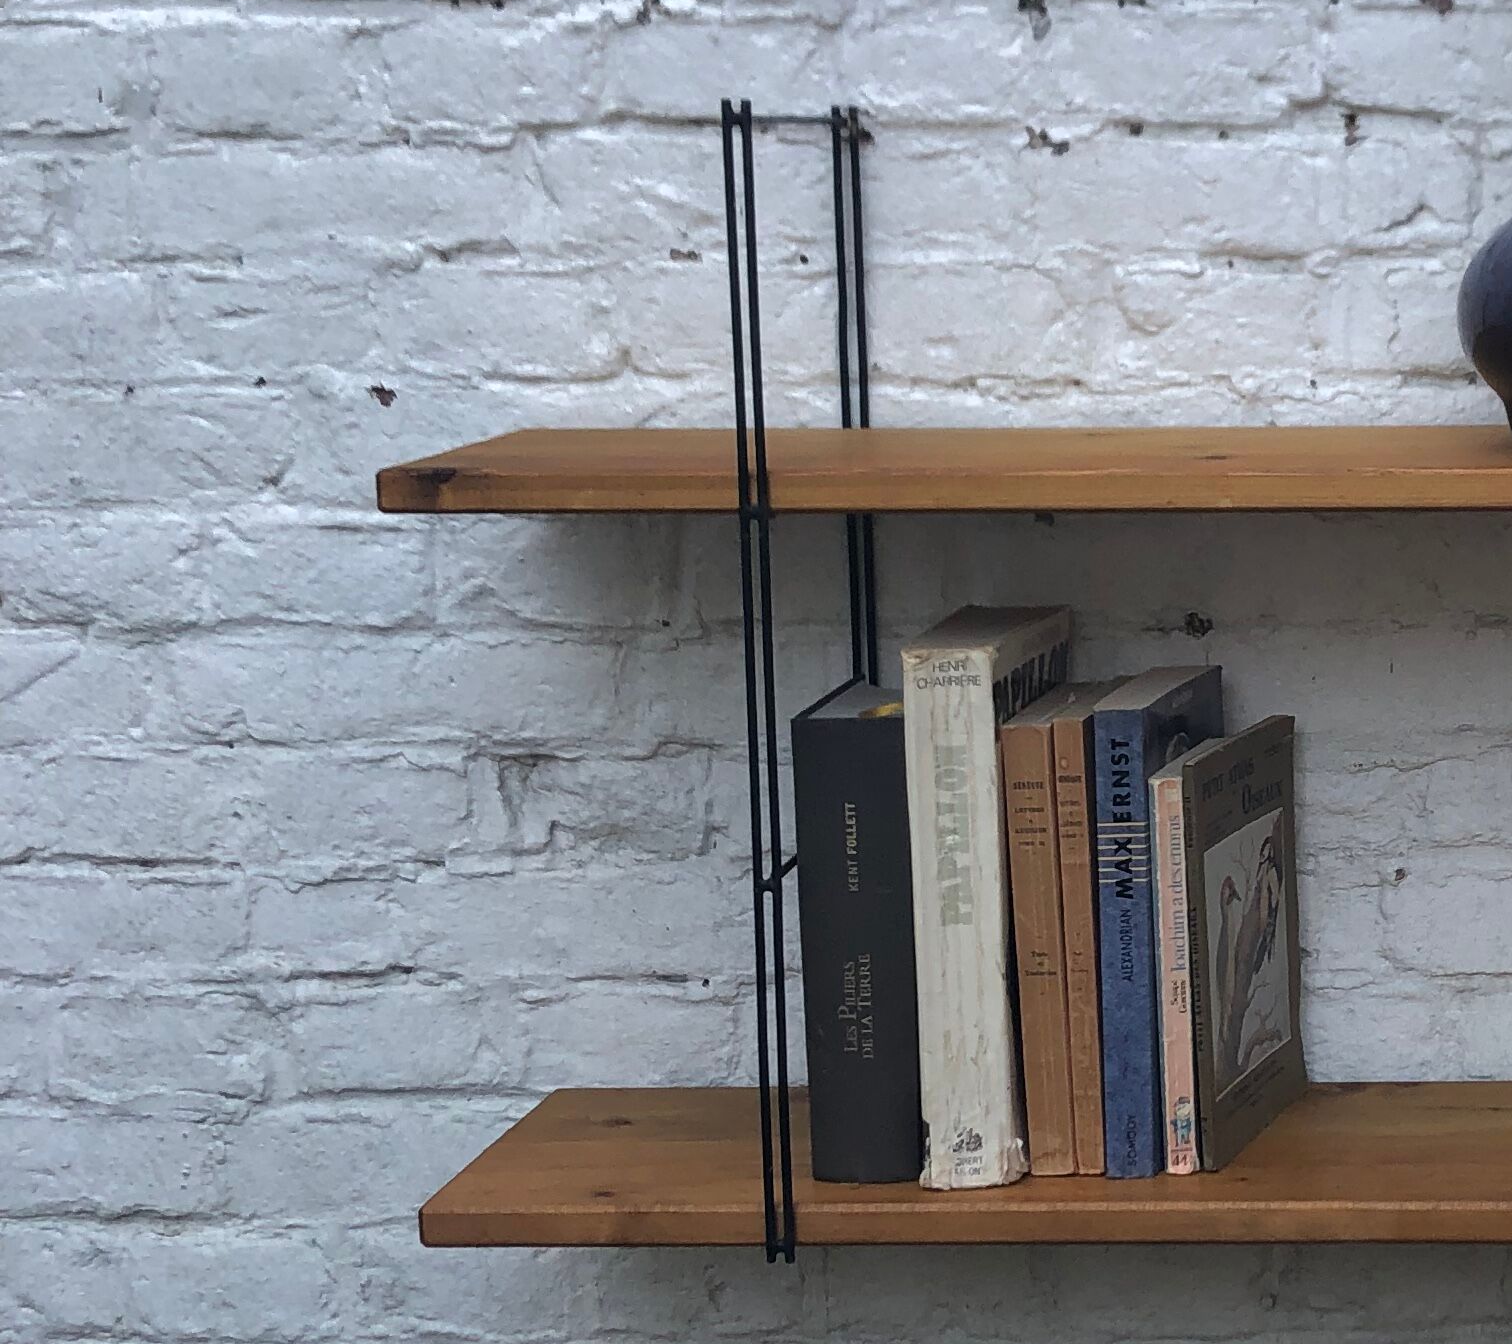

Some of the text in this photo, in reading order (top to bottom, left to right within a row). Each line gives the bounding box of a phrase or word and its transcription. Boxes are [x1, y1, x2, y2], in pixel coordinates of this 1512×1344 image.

[845, 803, 859, 892] KENT FOLLETT
[1111, 739, 1134, 900] MAX ERNST
[1167, 868, 1182, 894] des
[1120, 909, 1133, 983] ALEXANDRIAN
[839, 962, 858, 1053] LES PILIERS
[857, 954, 874, 1059] DE LA TERRE
